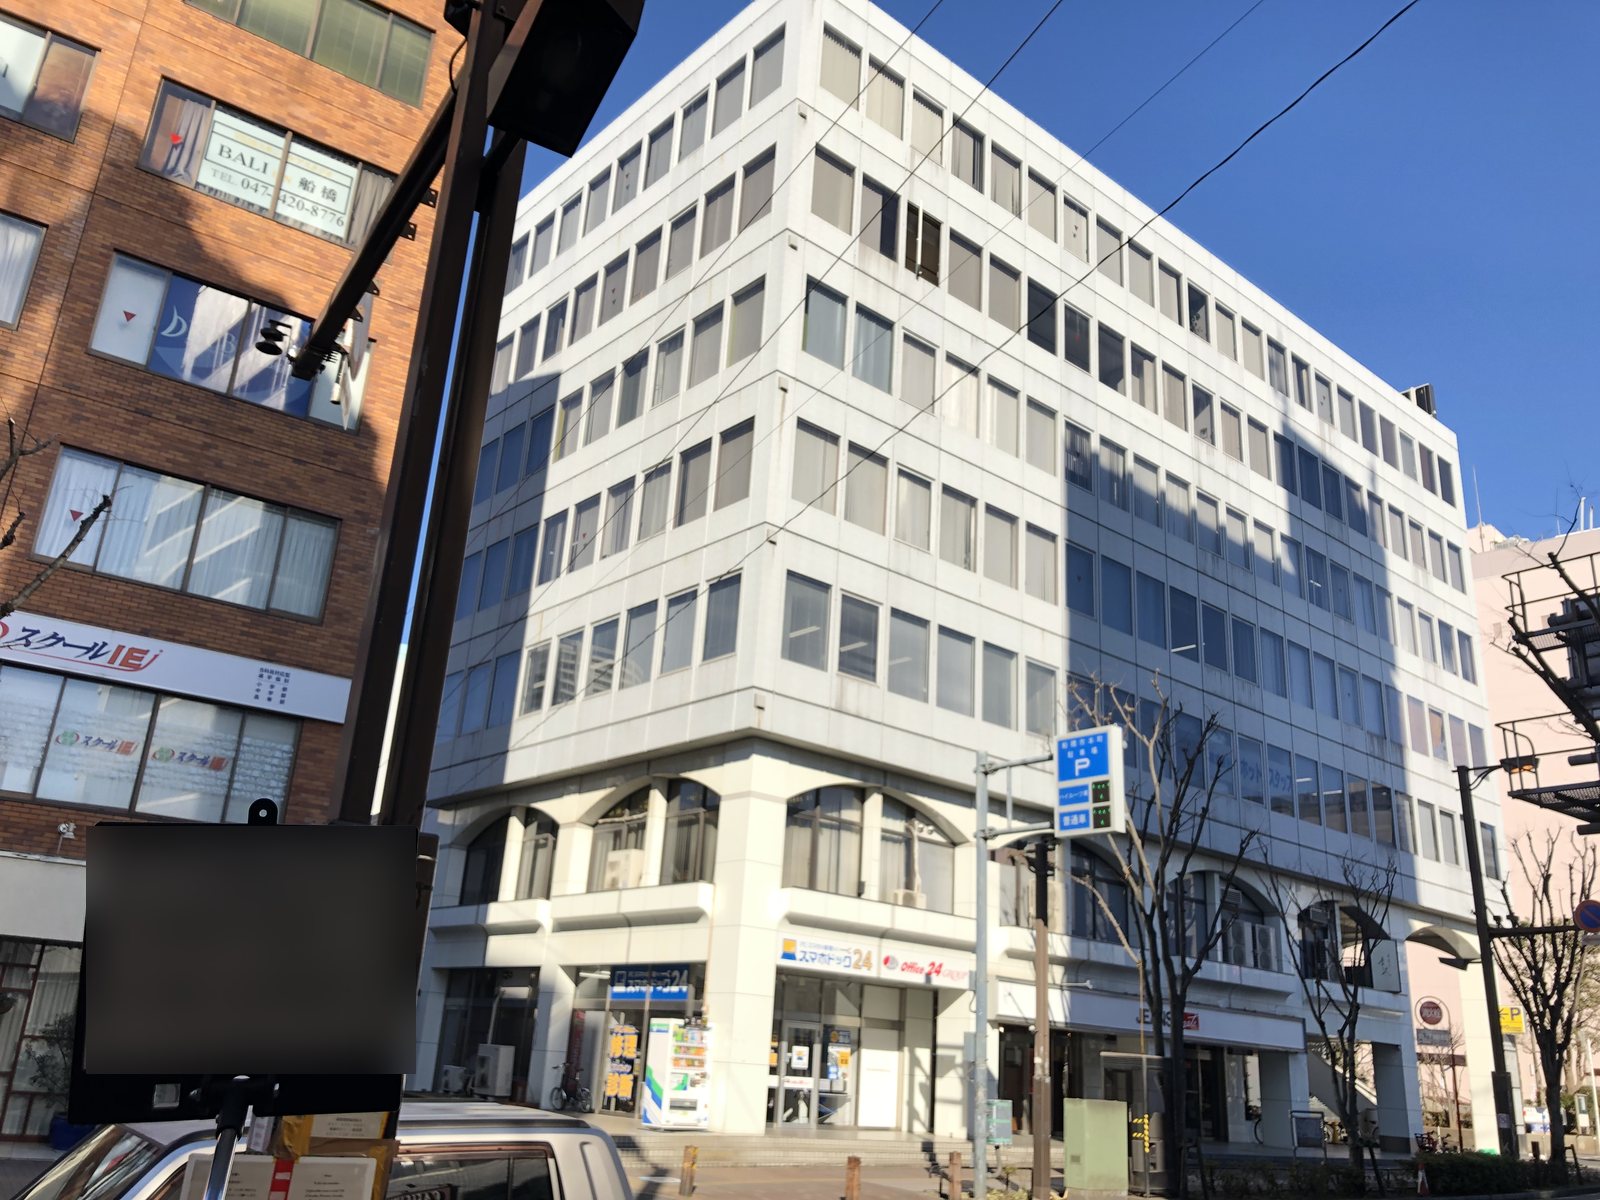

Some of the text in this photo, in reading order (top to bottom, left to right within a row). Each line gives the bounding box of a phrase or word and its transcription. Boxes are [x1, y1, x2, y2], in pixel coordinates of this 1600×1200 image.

[218, 144, 268, 175] BALI
[298, 176, 338, 203] 船橋
[1075, 757, 1090, 777] P
[901, 962, 925, 975] Office
[925, 961, 943, 976] 24
[1510, 1007, 1521, 1021] P
